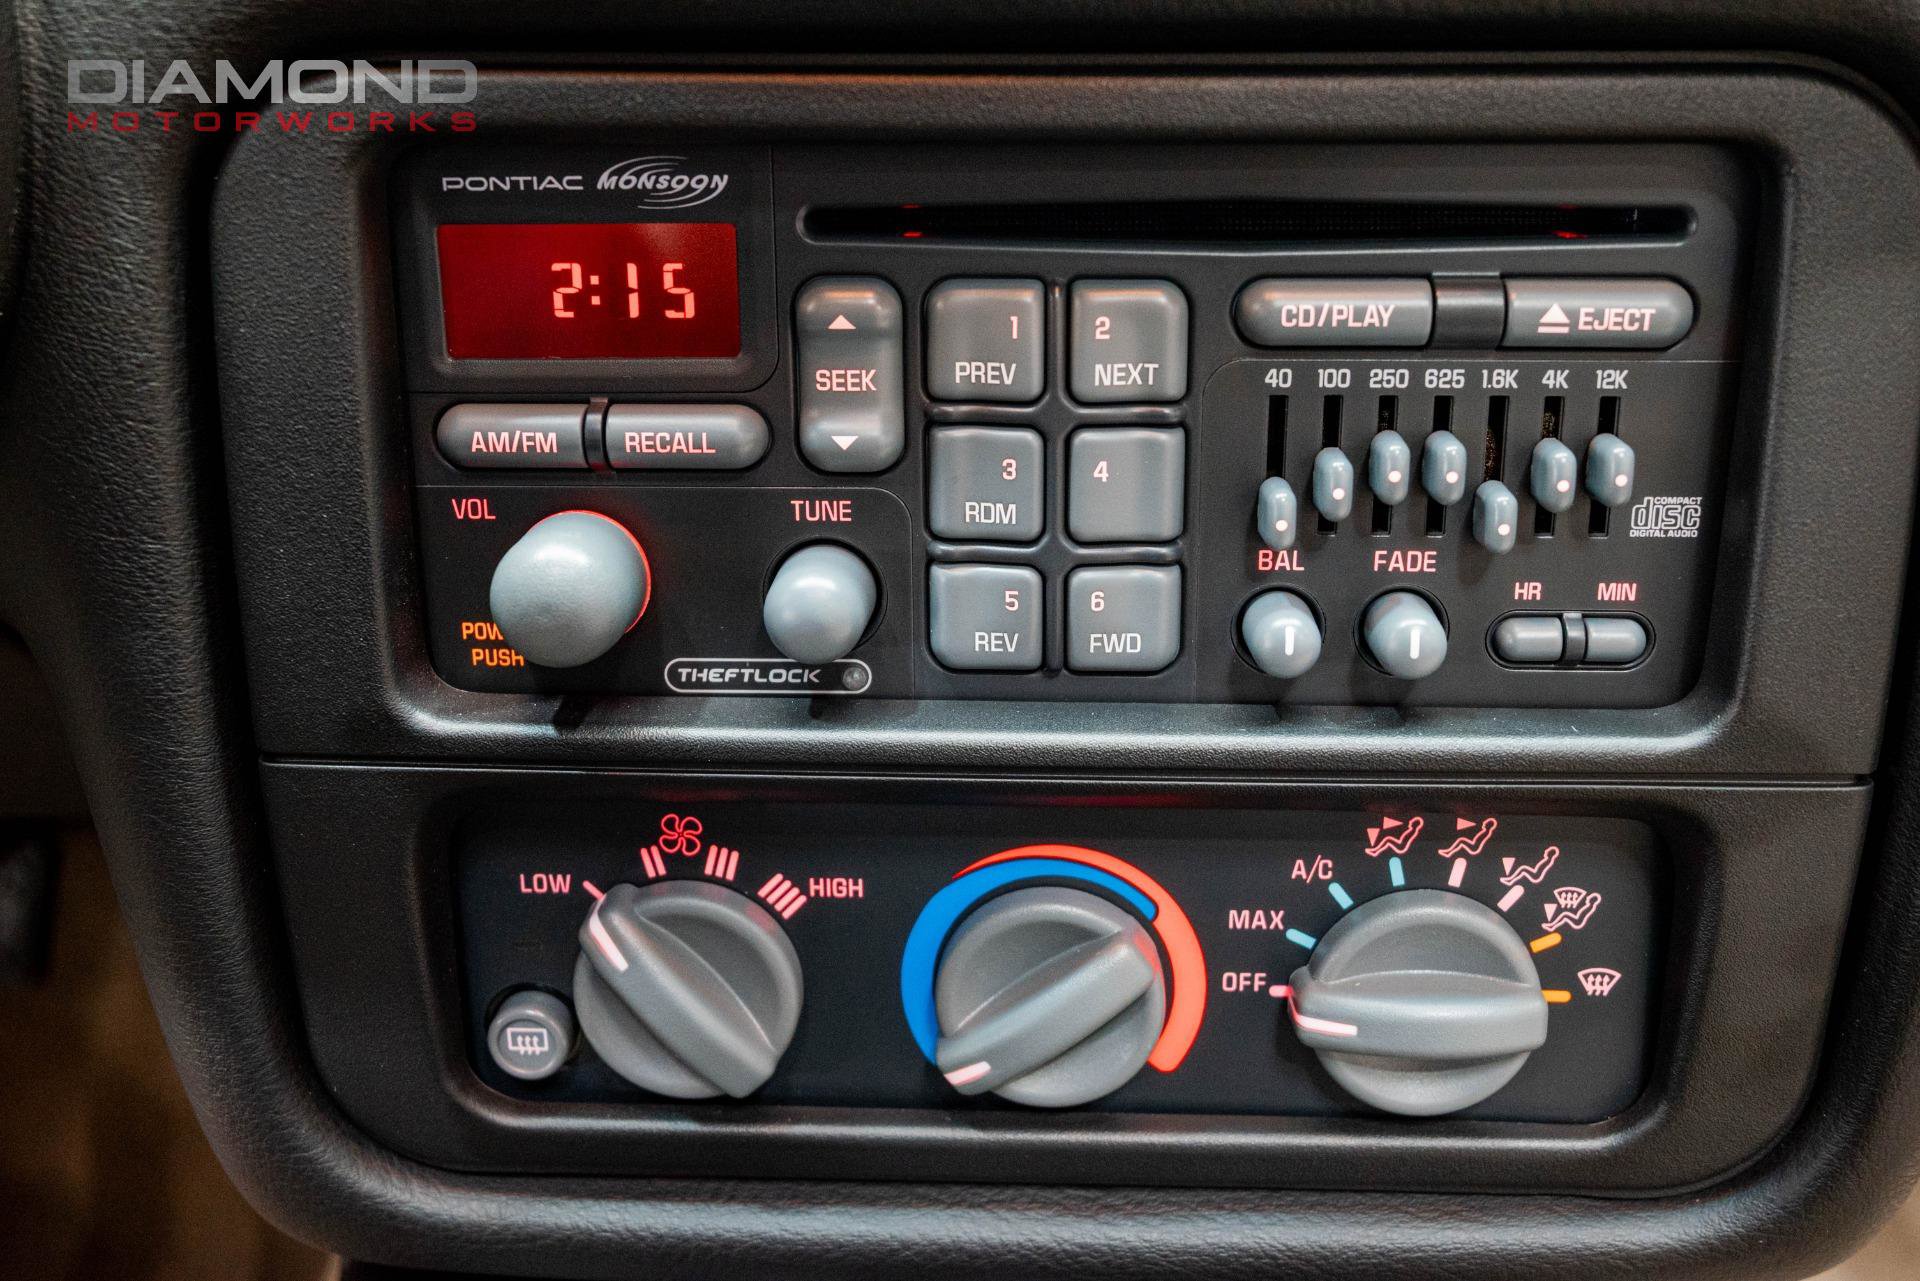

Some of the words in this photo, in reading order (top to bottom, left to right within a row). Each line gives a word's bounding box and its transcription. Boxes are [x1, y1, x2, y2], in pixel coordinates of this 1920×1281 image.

[442, 175, 584, 191] PONTIAC
[597, 167, 729, 201] MONSOON
[551, 262, 696, 319] 2:15
[1280, 303, 1396, 329] CD/PLAY
[1577, 307, 1657, 332] EJECT
[1009, 316, 1019, 339] 1
[1094, 317, 1110, 340] 2
[815, 369, 877, 392] SEEK
[954, 361, 1017, 386] PREV
[1094, 362, 1159, 387] NEXT
[1264, 369, 1292, 388] 40
[1317, 369, 1351, 389] 100
[1369, 369, 1410, 389] 250
[1424, 369, 1465, 390] 625
[1481, 369, 1518, 390] 1.6K
[1541, 370, 1569, 390] 4K
[1595, 370, 1628, 390] 12K
[470, 431, 558, 454] AM/FM
[624, 432, 716, 454] RECALL
[1002, 459, 1017, 481] 3
[1093, 461, 1109, 483] 4
[452, 498, 496, 520] VOL
[790, 500, 852, 522] TUNE
[1654, 497, 1702, 505] COMPACT
[964, 502, 1017, 525] RDM
[1630, 530, 1666, 538] DIGITAL
[1667, 530, 1698, 538] AUDIO
[1258, 550, 1305, 571] BAL
[1374, 550, 1437, 573] FADE
[1004, 590, 1019, 611] 5
[1090, 591, 1105, 612] 6
[1514, 582, 1542, 600] HR
[1597, 583, 1637, 601] MIN
[461, 622, 505, 640] POW
[974, 633, 1019, 652] REV
[1089, 634, 1141, 653] FWD
[471, 648, 526, 667] PUSH
[678, 668, 821, 683] THEFTLOCK
[1291, 855, 1333, 884] A/C
[519, 873, 571, 894] LOW
[809, 878, 864, 899] HIGH
[1228, 910, 1285, 930] MAX
[1222, 972, 1267, 992] OFF
